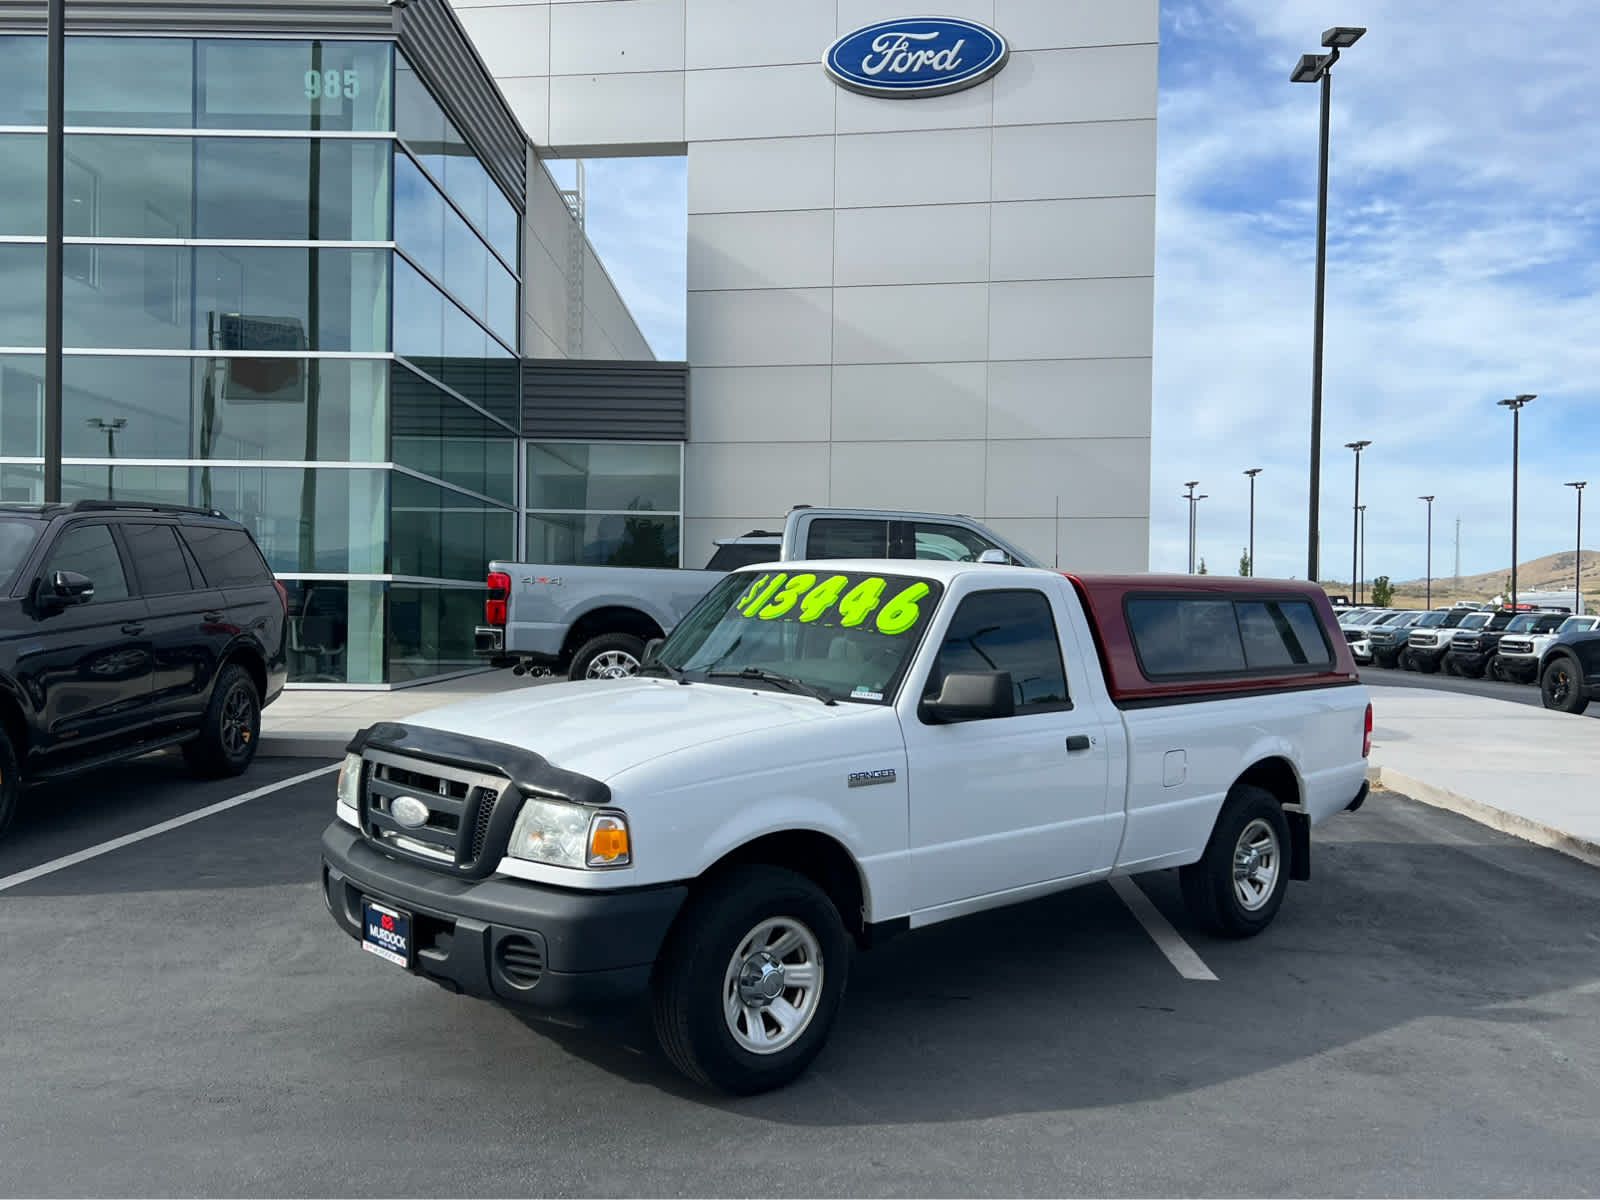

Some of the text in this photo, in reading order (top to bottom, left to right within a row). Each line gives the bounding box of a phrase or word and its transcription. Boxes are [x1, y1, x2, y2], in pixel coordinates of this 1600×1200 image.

[862, 32, 965, 75] Ford
[304, 69, 360, 99] 985
[737, 573, 929, 635] $13446
[848, 768, 896, 782] RANGER
[369, 923, 406, 949] MURDOCK
